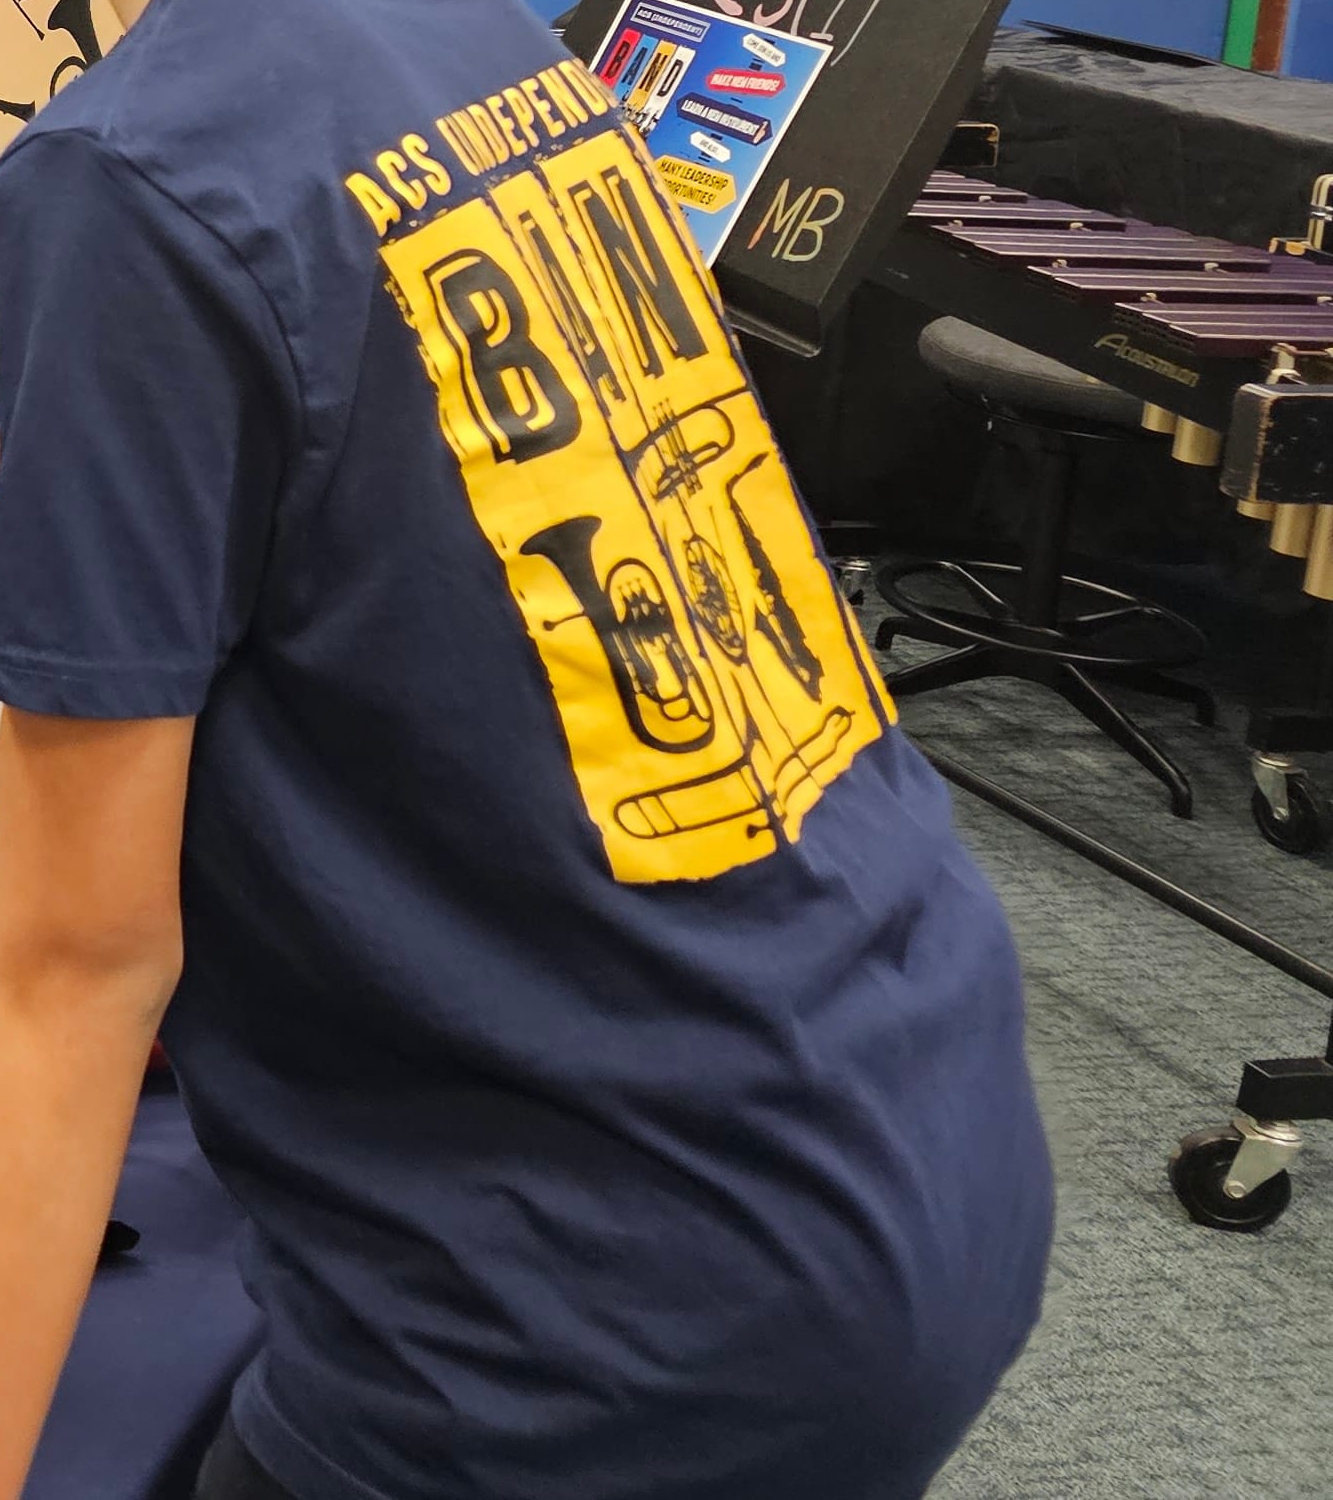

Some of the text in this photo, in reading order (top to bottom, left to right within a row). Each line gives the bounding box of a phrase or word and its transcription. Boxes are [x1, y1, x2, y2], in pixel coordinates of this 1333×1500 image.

[605, 41, 684, 97] BAND
[710, 73, 780, 92] MAKE NEW FRIENDS!
[680, 98, 705, 116] LEARN
[345, 133, 451, 236] ACS
[660, 159, 729, 191] MANY LEADERSHIP
[747, 178, 845, 262] MB
